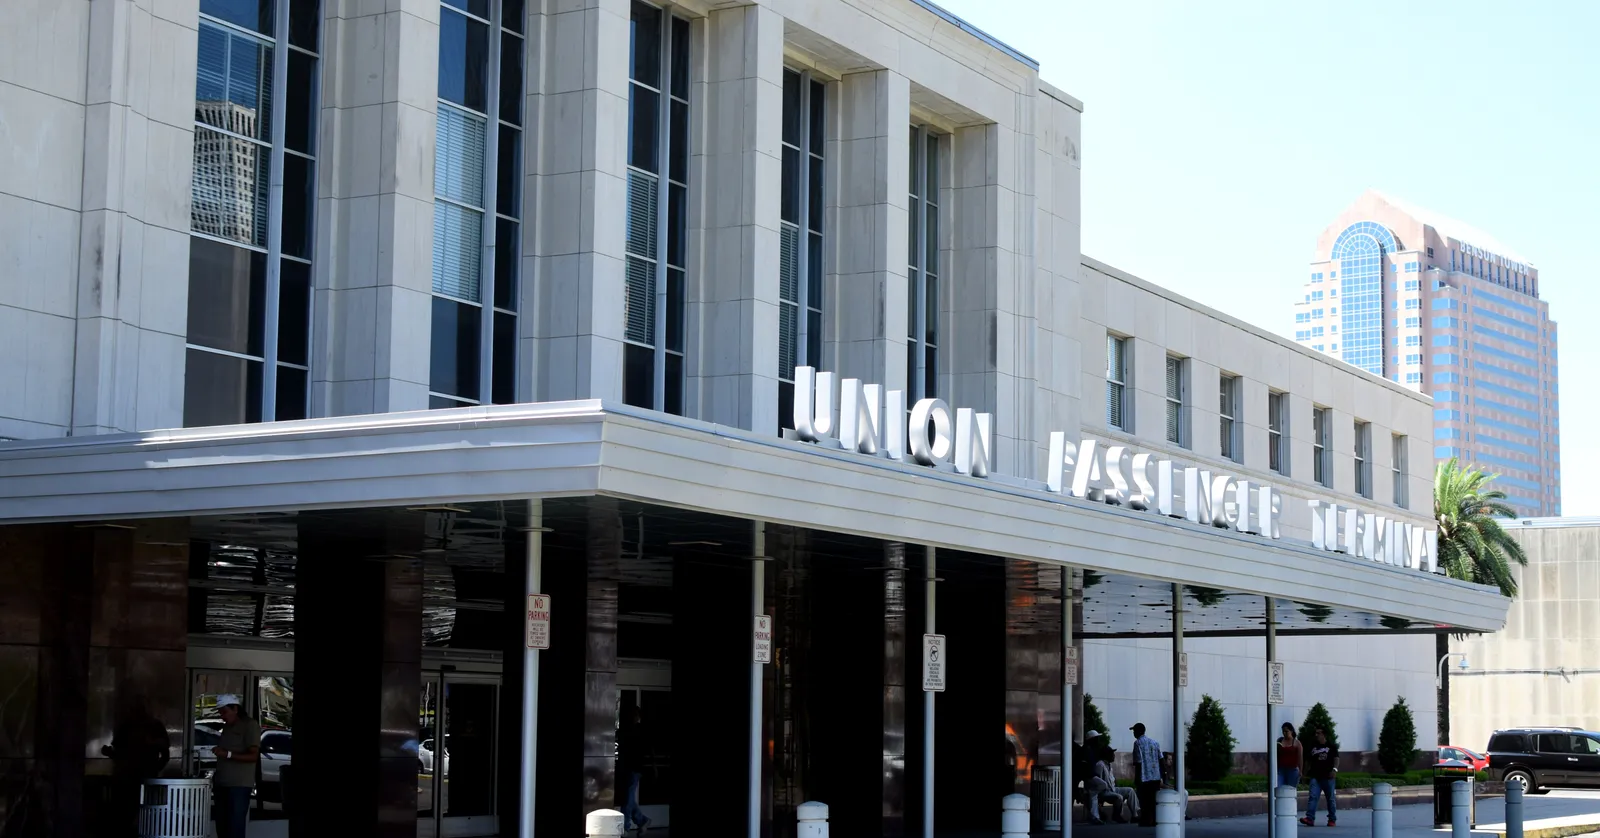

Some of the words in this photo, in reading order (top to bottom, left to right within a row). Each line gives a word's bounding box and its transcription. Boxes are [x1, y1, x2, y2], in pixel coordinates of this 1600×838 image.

[1460, 240, 1496, 264] BENSON
[1500, 255, 1529, 276] TOWER
[793, 366, 993, 478] UNION
[1047, 431, 1282, 539] PASSENGER
[534, 598, 544, 609] NO
[528, 610, 549, 621] PARKING
